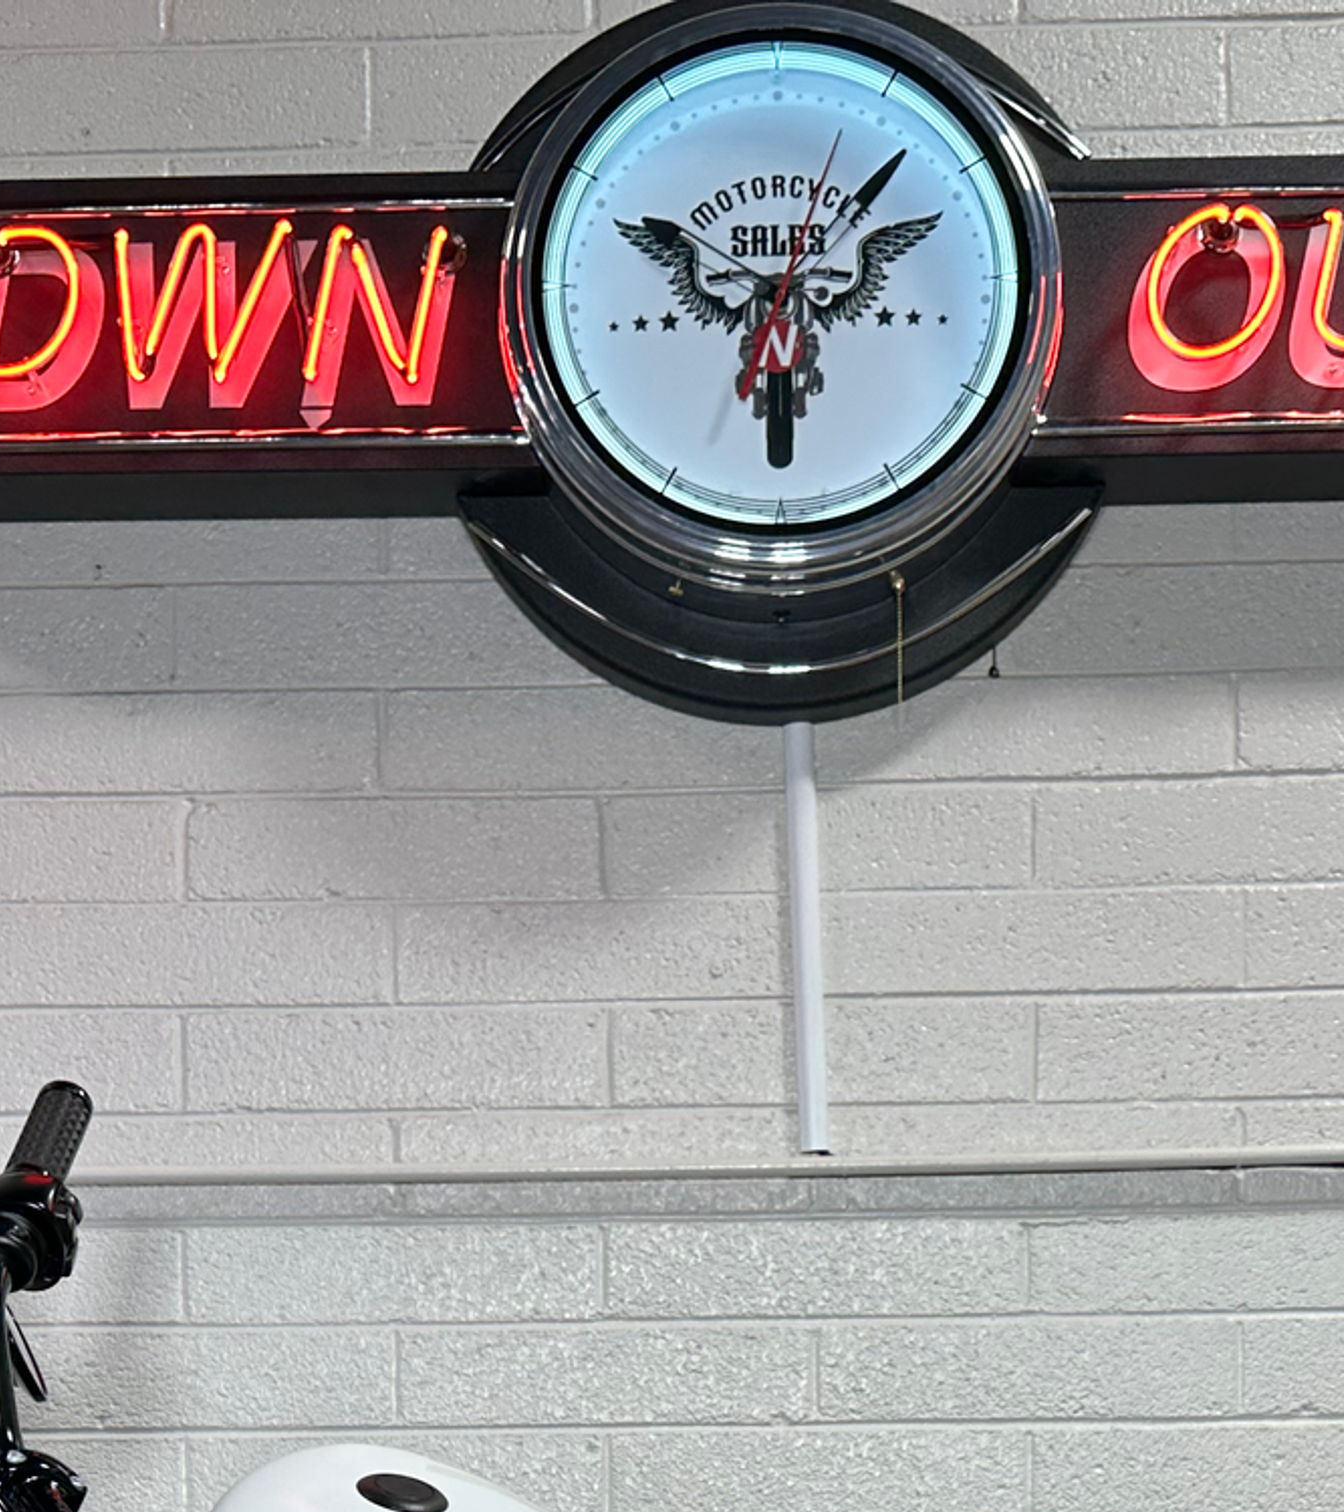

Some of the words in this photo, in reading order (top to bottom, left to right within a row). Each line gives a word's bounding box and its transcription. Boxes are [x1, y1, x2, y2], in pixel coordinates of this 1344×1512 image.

[689, 174, 872, 231] MOTORCYCLE
[729, 223, 827, 258] SALES
[757, 324, 799, 368] N
